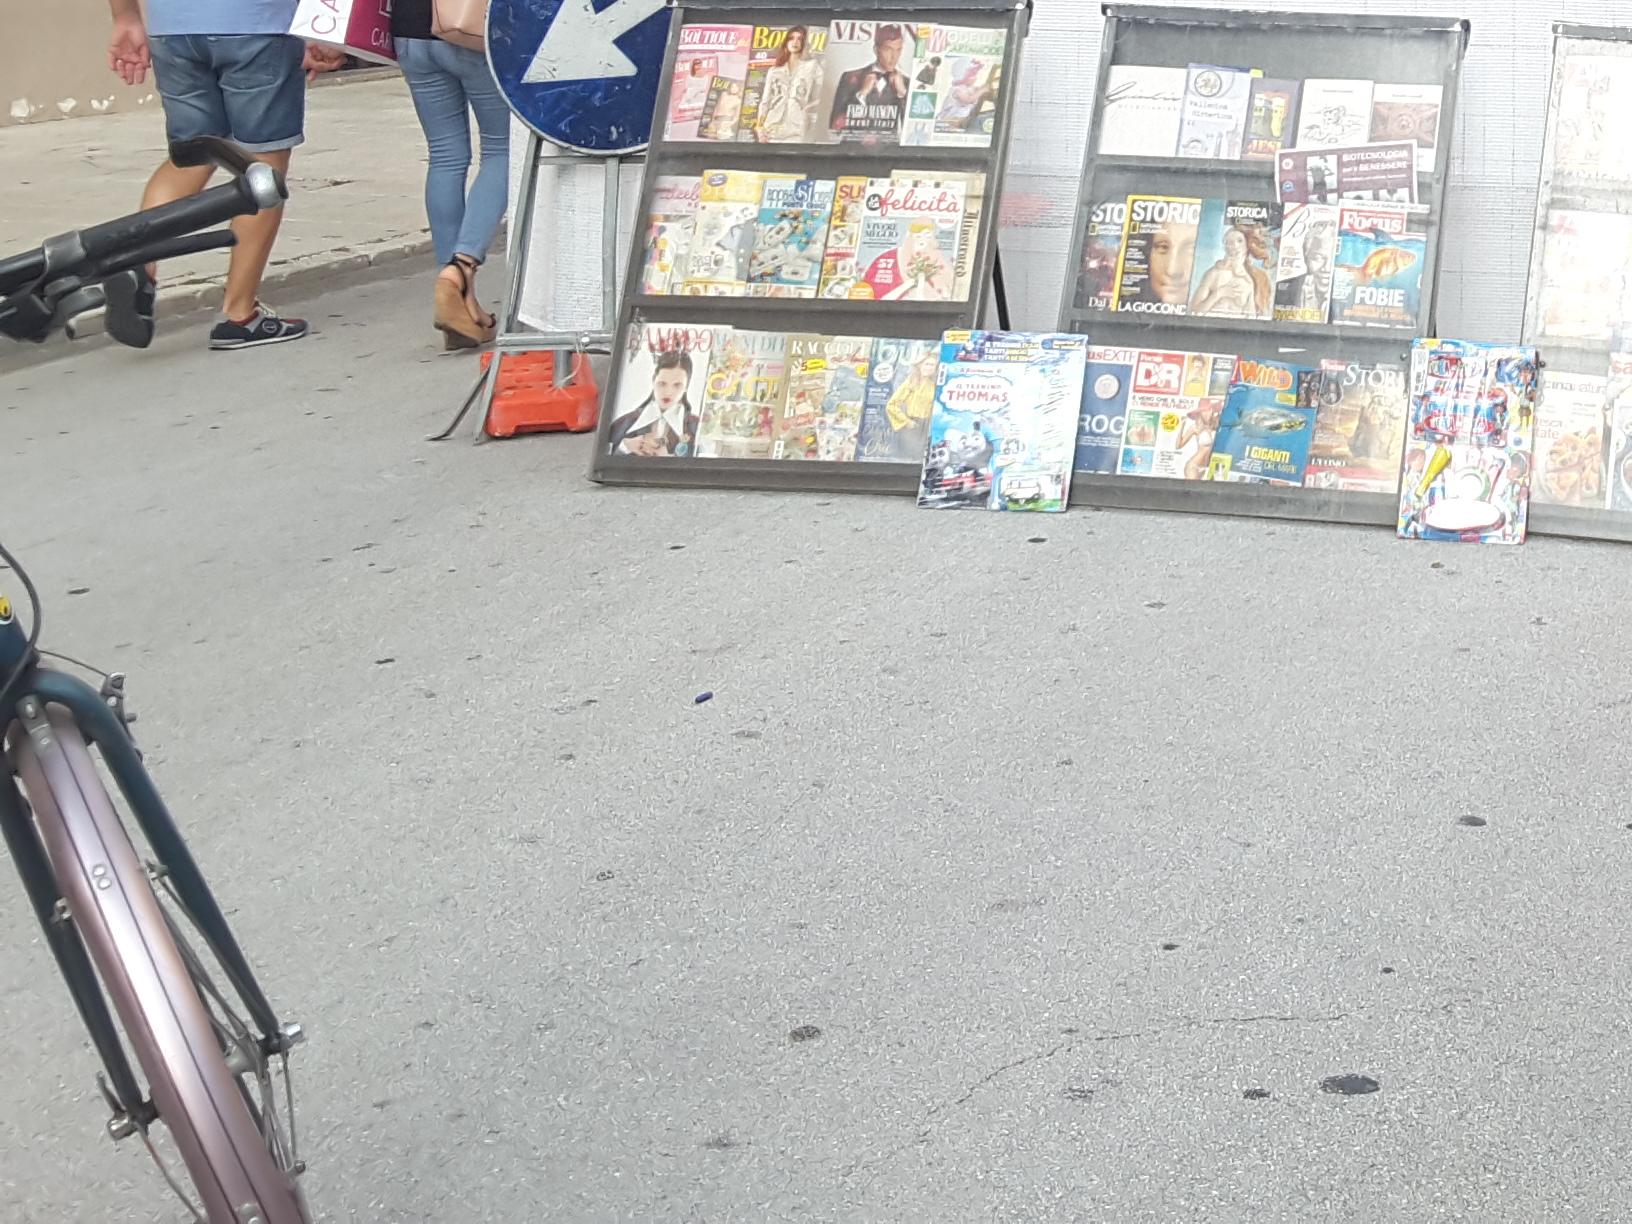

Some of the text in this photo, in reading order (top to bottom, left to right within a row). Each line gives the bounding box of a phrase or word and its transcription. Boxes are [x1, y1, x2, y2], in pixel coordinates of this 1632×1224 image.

[881, 188, 960, 217] felicità
[1226, 206, 1268, 219] STORICA
[1354, 286, 1406, 307] FOBIE
[1117, 301, 1132, 312] LA
[1239, 360, 1293, 391] WILD
[947, 390, 1009, 403] THOMAS
[1251, 446, 1291, 464] GIGANTI
